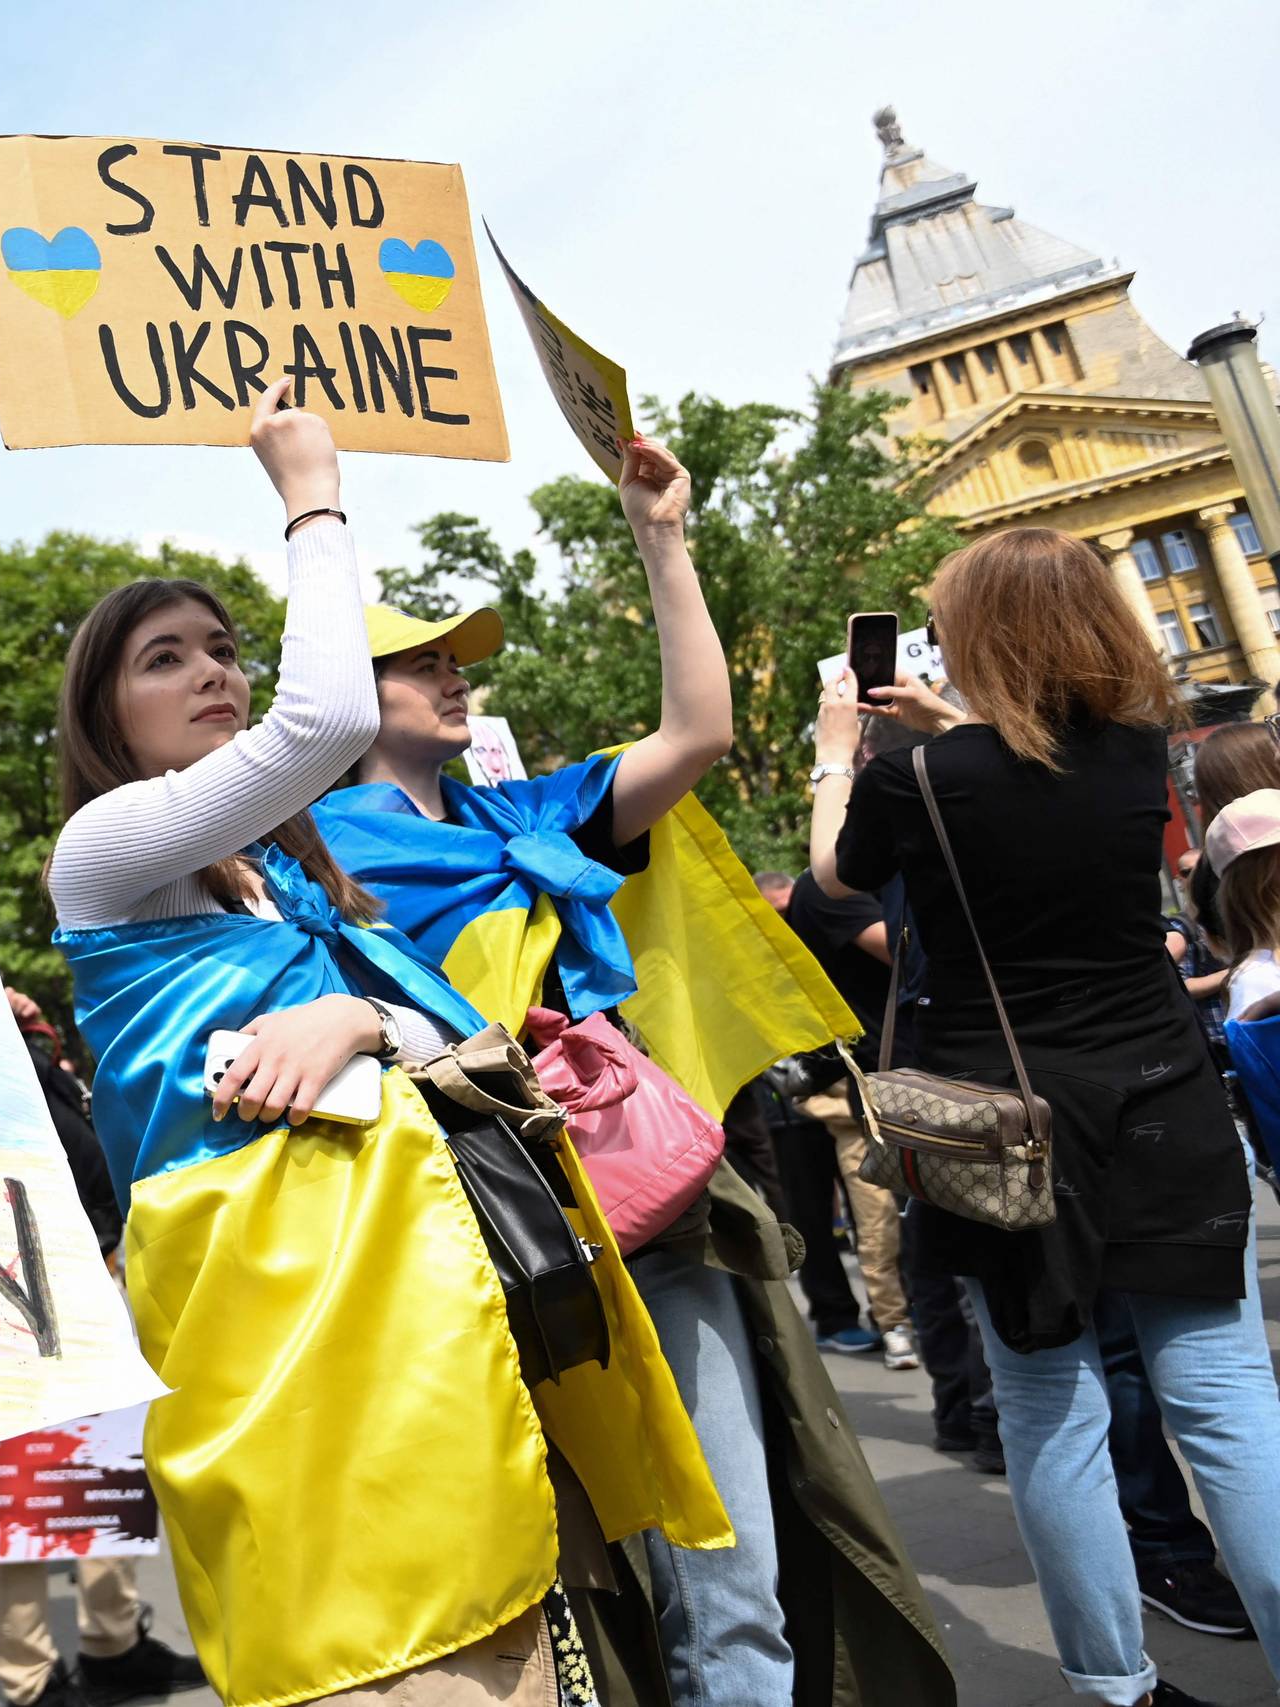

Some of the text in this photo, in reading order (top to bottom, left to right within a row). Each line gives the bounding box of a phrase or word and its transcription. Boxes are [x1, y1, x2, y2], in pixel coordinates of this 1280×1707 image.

[97, 144, 385, 236] STAND
[154, 240, 356, 311] WITH
[98, 319, 470, 426] UKRAINE
[574, 371, 620, 460] BE ME
